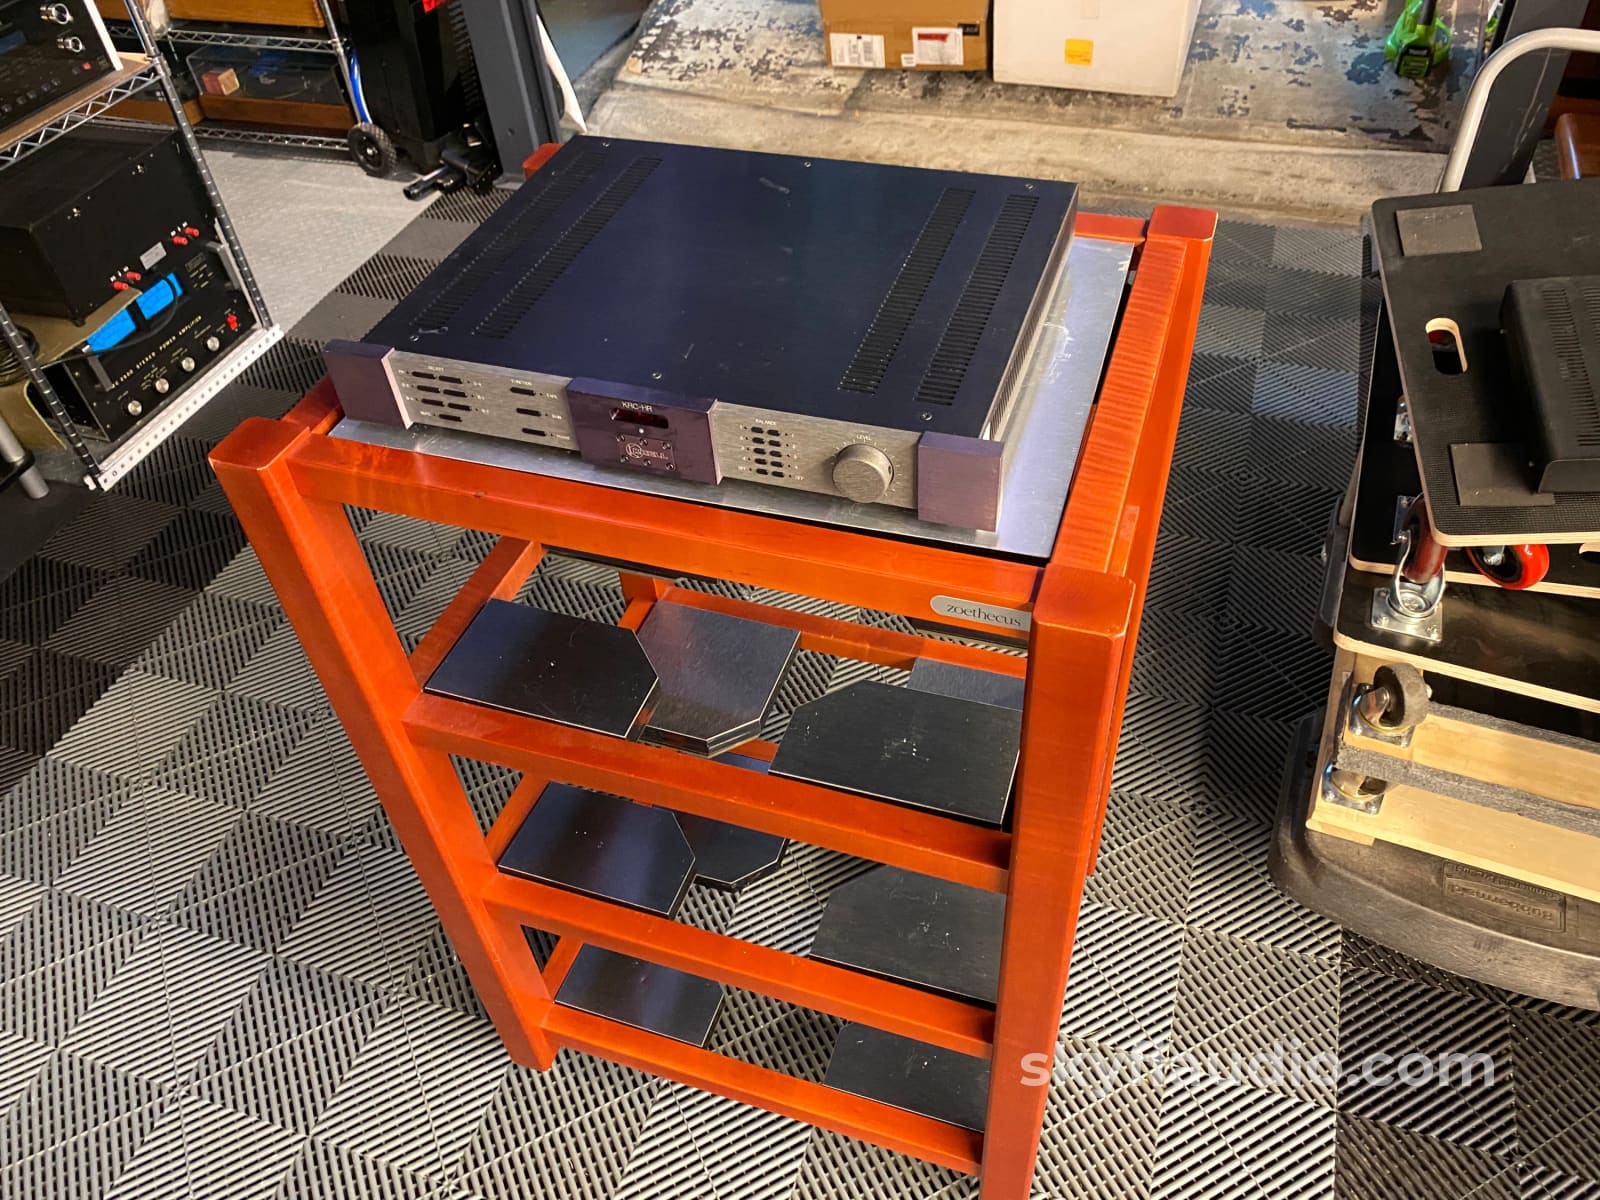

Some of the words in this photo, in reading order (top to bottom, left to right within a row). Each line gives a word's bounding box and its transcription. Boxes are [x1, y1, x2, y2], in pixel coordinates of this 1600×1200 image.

[136, 351, 156, 369] STEREO
[159, 335, 176, 351] POWER
[178, 315, 202, 336] AMPLIFIER
[621, 401, 653, 413] KRC-HR
[755, 418, 777, 426] BALANCE
[857, 433, 872, 441] LEVEL
[946, 604, 1022, 626] zoethecus
